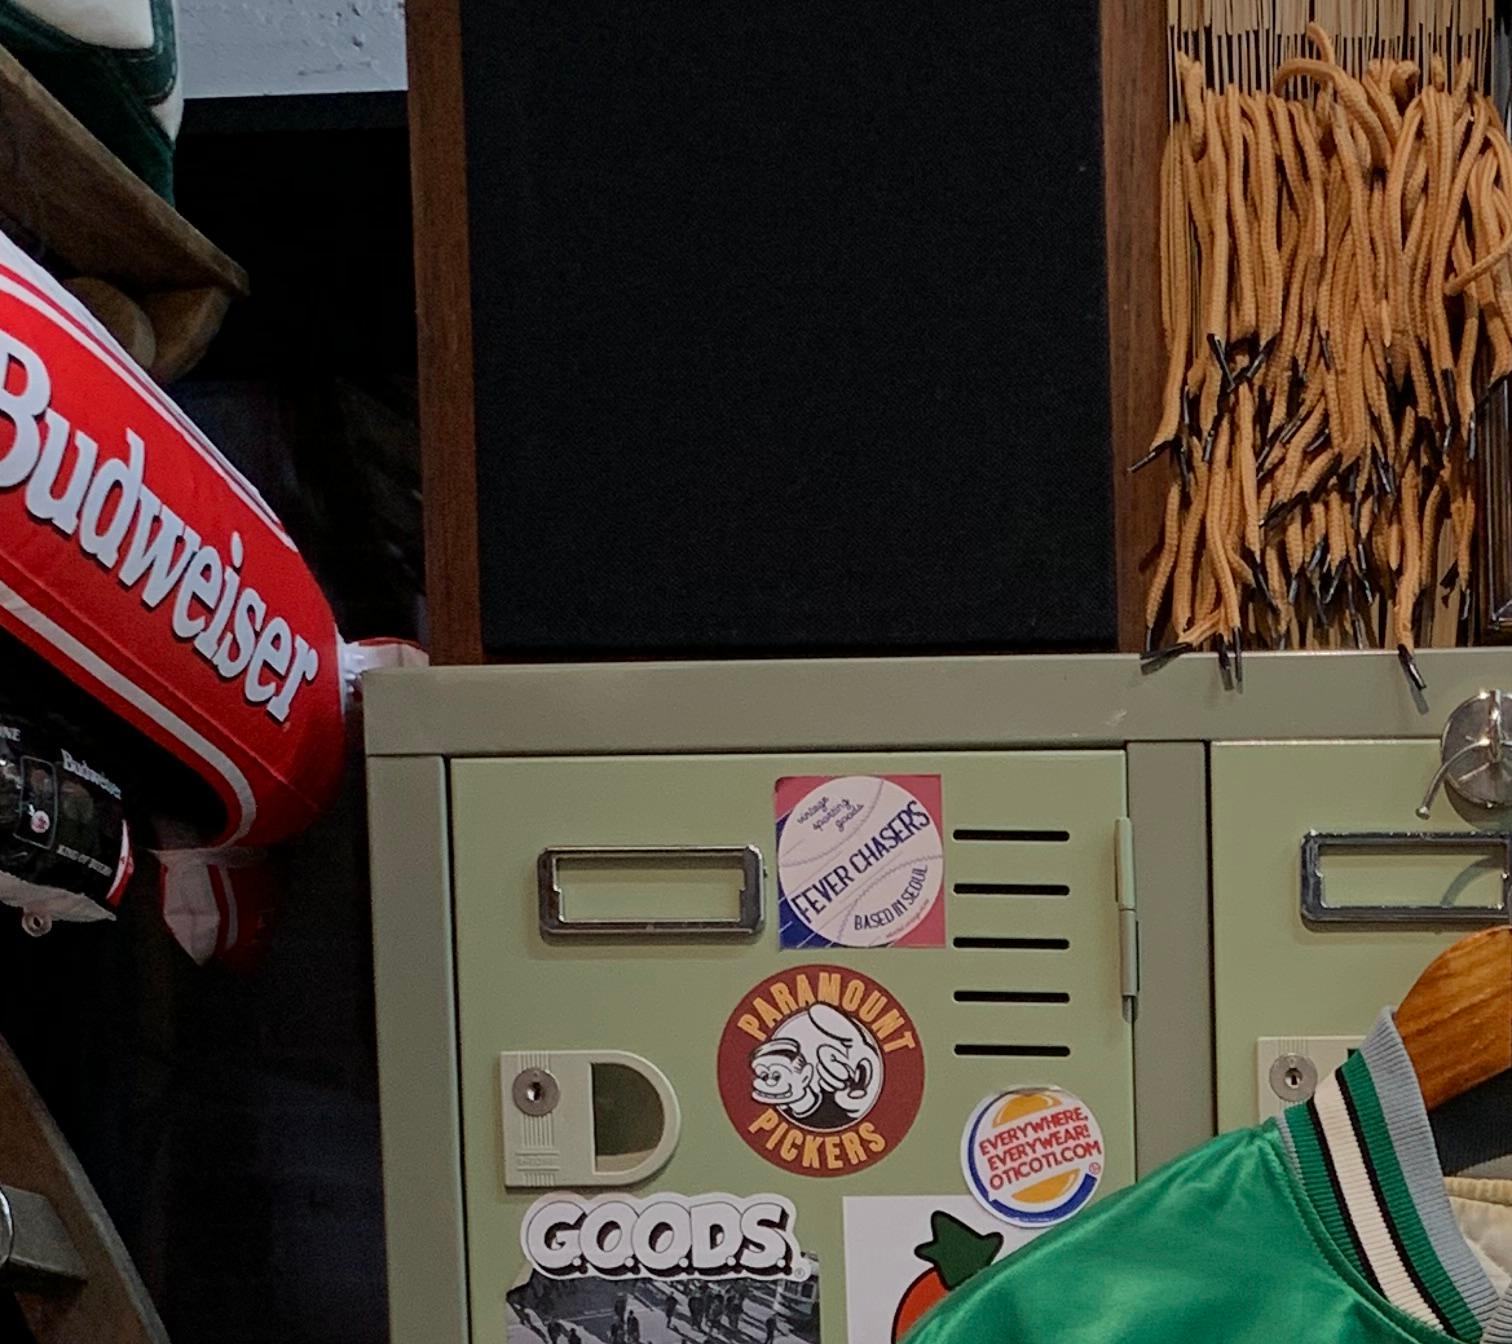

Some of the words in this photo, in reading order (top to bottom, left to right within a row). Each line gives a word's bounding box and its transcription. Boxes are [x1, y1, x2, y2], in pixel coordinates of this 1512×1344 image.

[0, 328, 319, 723] Budweiser
[790, 865, 855, 925] FEVER
[848, 799, 931, 875] CHASERS
[854, 907, 896, 931] BASED
[900, 864, 928, 906] SEOUL
[737, 971, 917, 1053] PARAMOUNT
[748, 1108, 887, 1170] PICKERS
[987, 1123, 1091, 1172] EVERYWEAR!
[989, 1140, 1103, 1191] OTICOTI.COM
